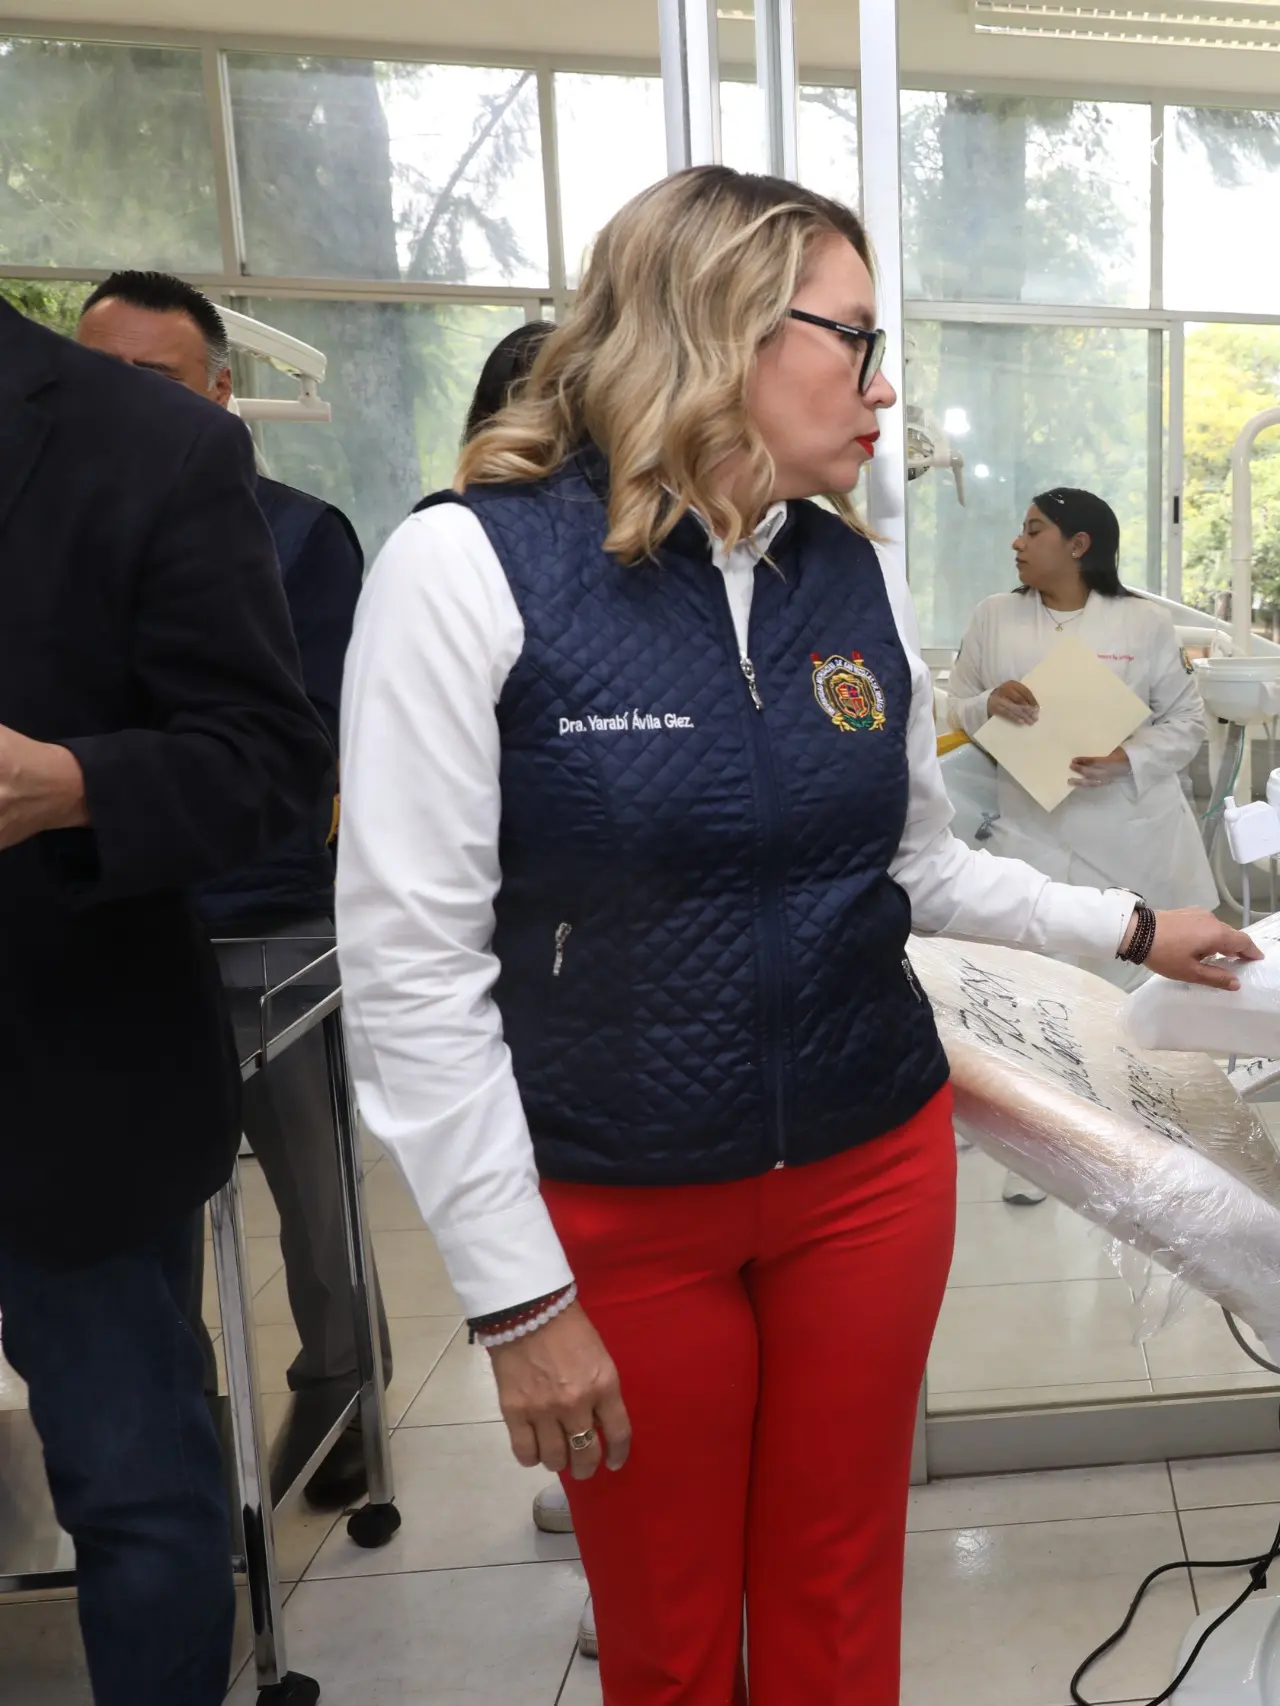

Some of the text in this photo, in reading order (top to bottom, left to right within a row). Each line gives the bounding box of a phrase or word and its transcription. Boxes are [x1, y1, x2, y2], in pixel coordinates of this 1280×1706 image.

[559, 707, 695, 736] Dra. Yarabí Ávila Glez.
